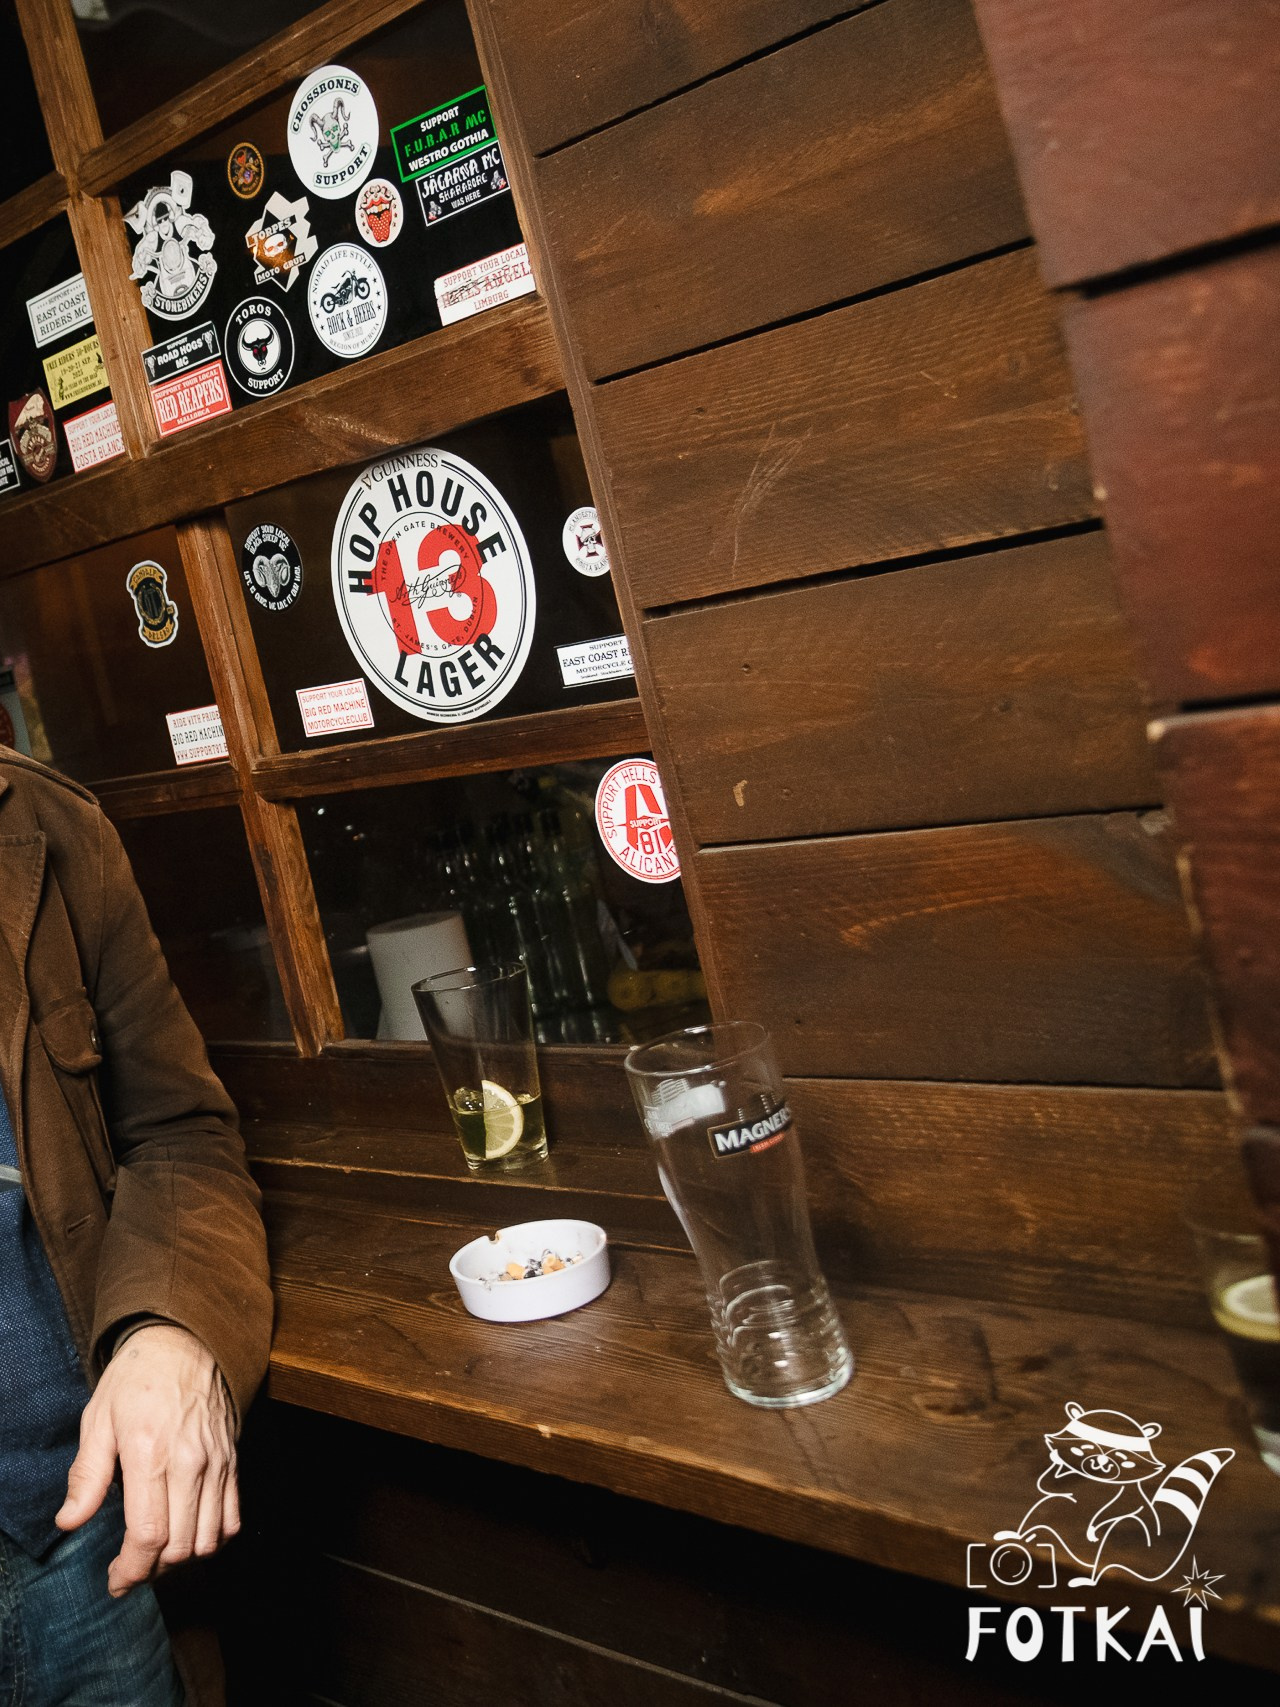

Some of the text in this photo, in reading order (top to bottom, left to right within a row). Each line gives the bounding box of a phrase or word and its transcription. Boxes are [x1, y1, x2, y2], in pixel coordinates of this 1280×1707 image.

[292, 79, 359, 132] CROSSBONES
[420, 106, 459, 132] SUPPORT
[465, 109, 486, 130] MC
[408, 128, 489, 171] WESTRO GOTHIA
[481, 148, 500, 170] MC
[315, 146, 369, 186] SUPPORT
[451, 189, 481, 209] WAS HERE
[251, 218, 292, 241] TORPES
[258, 255, 305, 281] MOTO GRUP
[330, 250, 348, 262] LIFE
[350, 250, 374, 272] STYLE
[444, 247, 526, 288] SUPPORT YOUR LOCAL
[485, 260, 532, 292] ANGEL
[154, 274, 208, 313] STONEBIKERS
[474, 290, 508, 310] LIMBURG
[36, 291, 86, 324] EAST COAST
[40, 304, 88, 336] RIDERS MC
[235, 303, 272, 325] TOROS
[326, 311, 347, 335] ROCK
[157, 338, 203, 365] ROAD HOGS
[166, 337, 188, 350] SUPPORT
[175, 356, 189, 369] MC
[155, 369, 219, 399] SUPPORT YOUR LOCAL
[247, 369, 284, 390] SUPPORT
[157, 377, 224, 423] RED REAPERS
[82, 432, 94, 448] RED
[75, 450, 98, 468] COSTA
[371, 452, 439, 483] GUINNESS
[347, 470, 507, 594] HOP HOUSE
[385, 531, 402, 556] OPEN
[404, 521, 426, 532] GATE
[430, 522, 470, 560] BREWERY
[364, 524, 497, 655] 13
[464, 596, 478, 633] DUBLIN
[589, 640, 623, 651] SUPPORT
[394, 632, 506, 698] LAGER
[562, 656, 586, 668] EAST
[588, 650, 618, 662] COAST
[576, 660, 626, 674] MOTORCYCLE
[305, 699, 366, 717] BIG RED MACHINE
[307, 713, 368, 730] MOTORCYCLECLUB
[172, 725, 224, 746] BIG RED MACHIN
[603, 767, 657, 839] SUPPORT HELLS
[639, 829, 663, 855] 81
[620, 846, 678, 874] ALICANT
